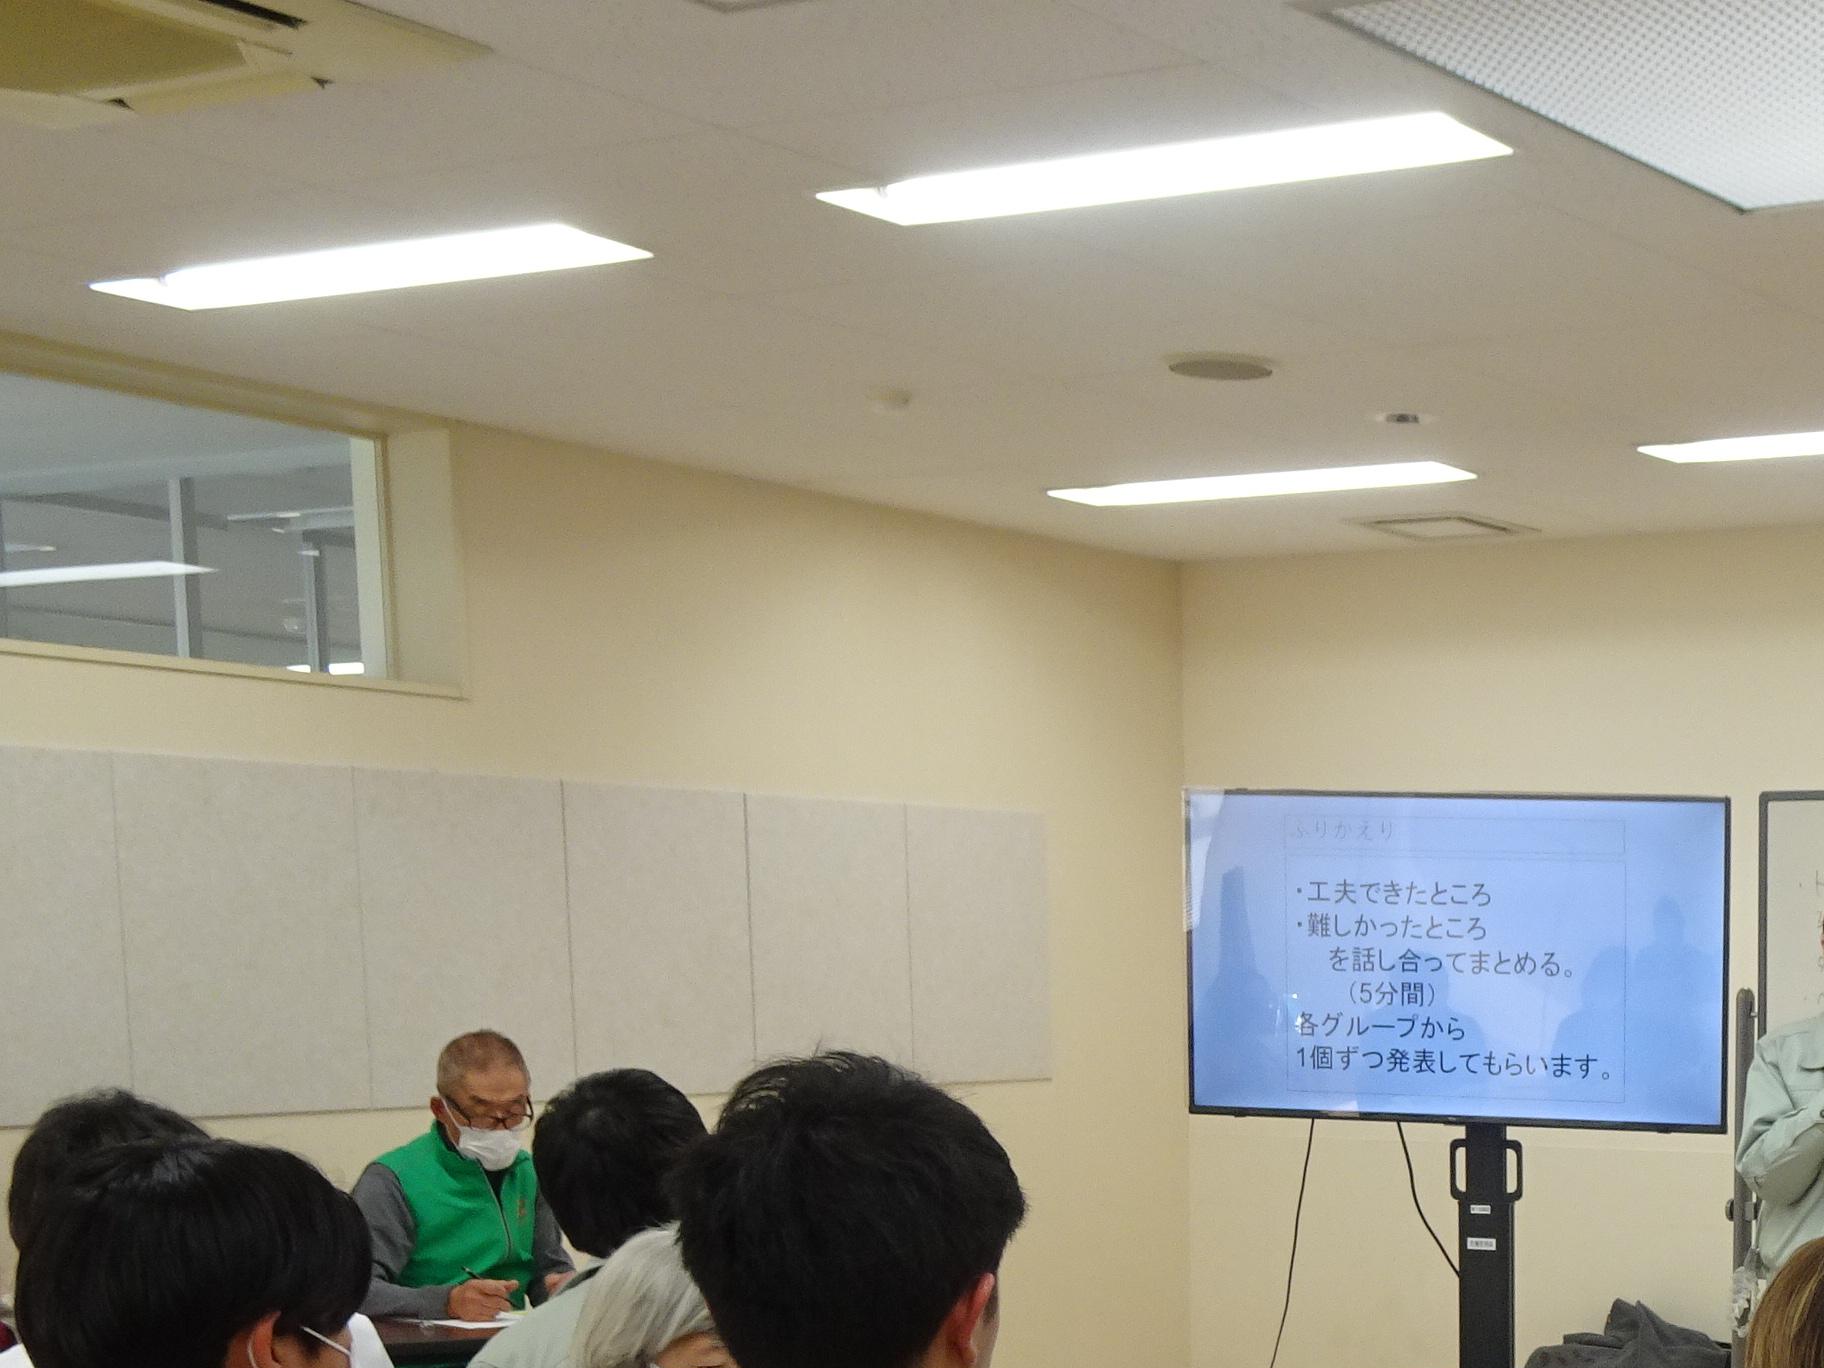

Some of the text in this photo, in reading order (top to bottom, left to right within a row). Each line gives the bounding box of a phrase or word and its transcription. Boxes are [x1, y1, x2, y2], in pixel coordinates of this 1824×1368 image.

[1294, 820, 1393, 841] ふりかえり
[1329, 947, 1574, 979] を話し合ってまとめる。
[1298, 1012, 1466, 1040] 各グループから
[1297, 1046, 1611, 1081] 1個ずつ発表してもらいます。
